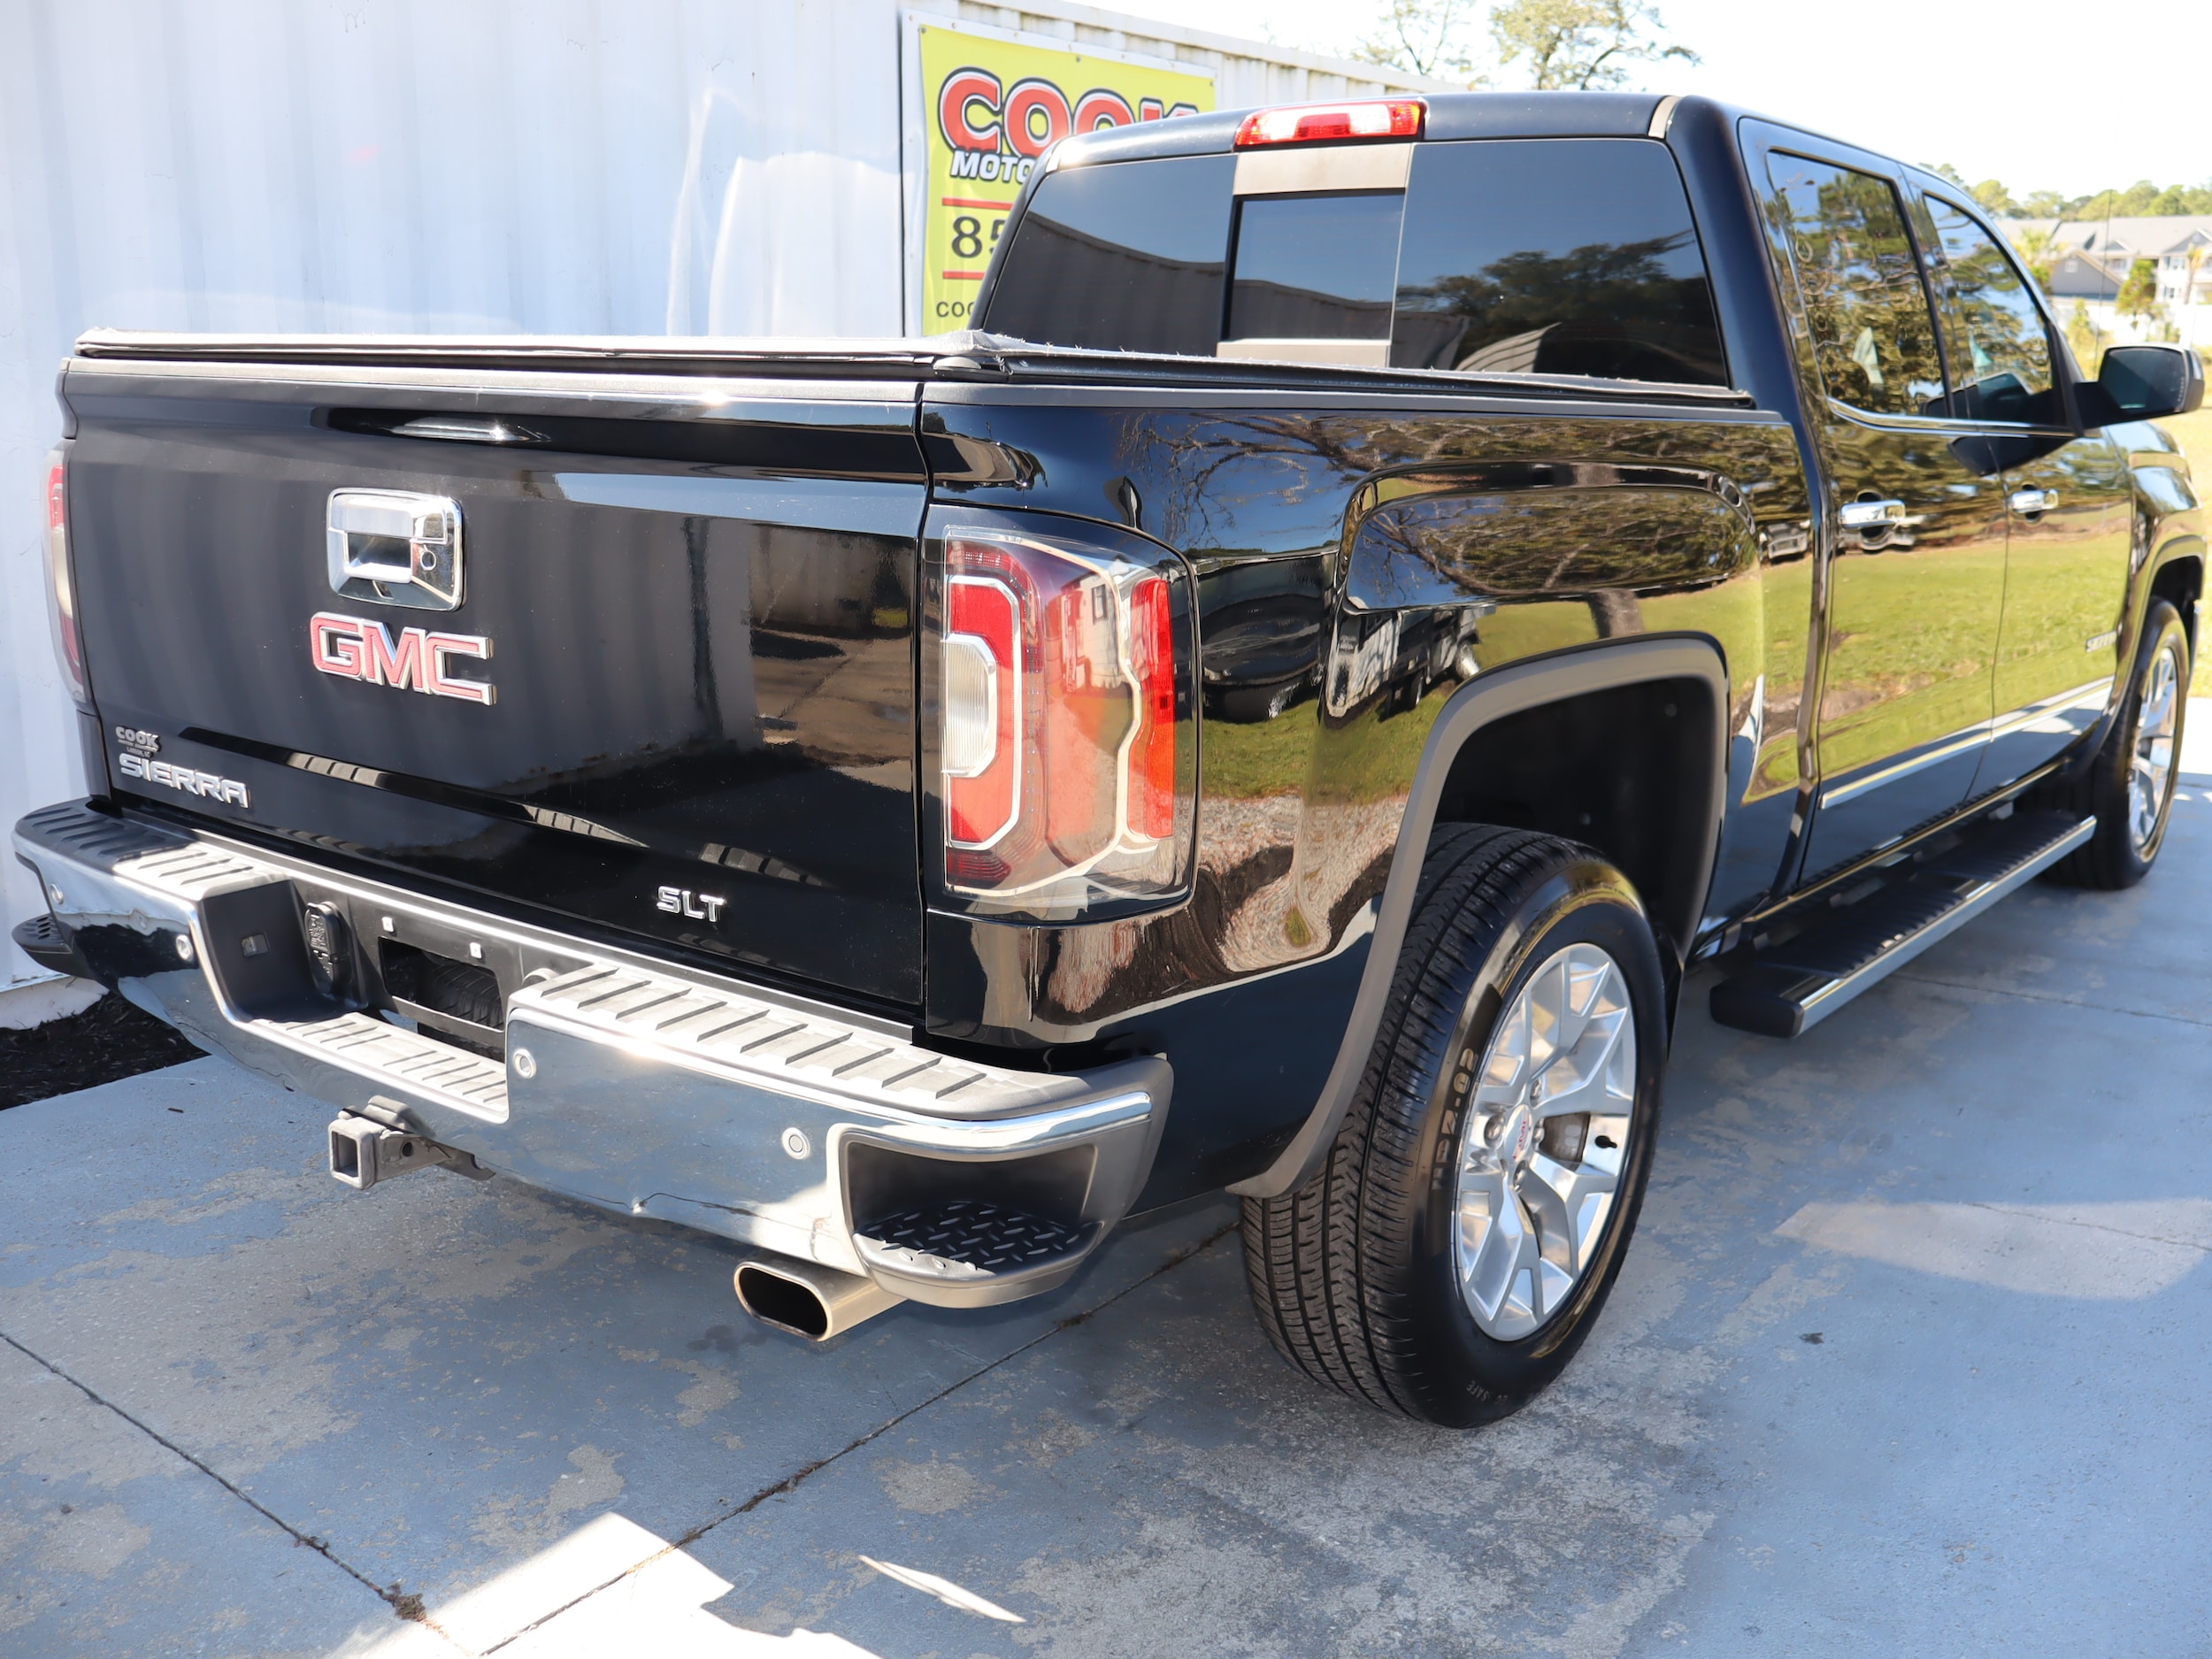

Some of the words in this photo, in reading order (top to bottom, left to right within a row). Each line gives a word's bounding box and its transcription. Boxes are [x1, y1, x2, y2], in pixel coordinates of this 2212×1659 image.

[311, 611, 497, 706] GMC
[115, 726, 160, 749] COOK
[119, 752, 250, 809] SIERRA
[657, 886, 726, 922] SLT
